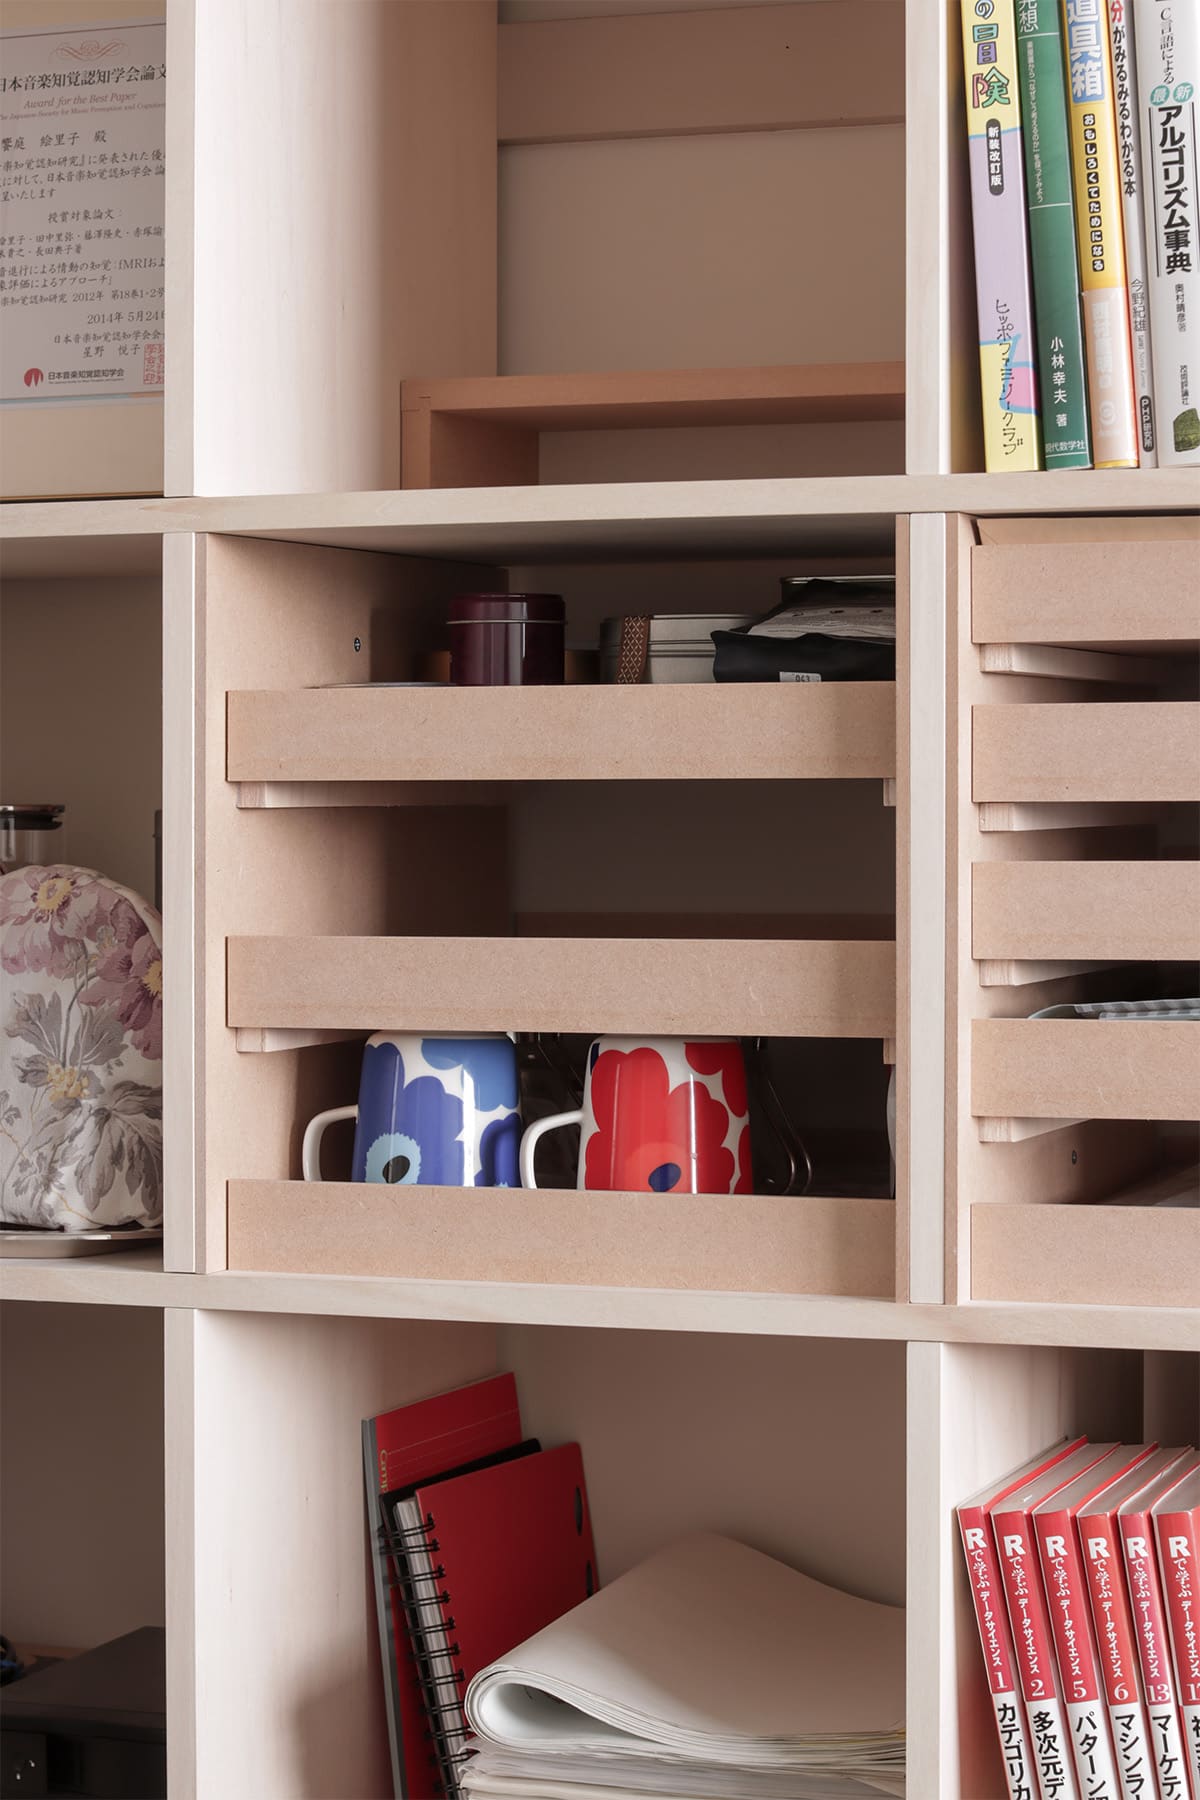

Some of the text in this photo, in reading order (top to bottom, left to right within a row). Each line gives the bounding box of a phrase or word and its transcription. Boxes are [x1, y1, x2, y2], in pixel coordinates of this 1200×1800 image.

[1066, 0, 1103, 98] 道具箱
[23, 92, 137, 109] Award for the Best Paper
[1110, 0, 1137, 197] 分がみるみるわかる本
[988, 126, 1002, 187] 新装改訂版
[1083, 114, 1104, 271] おもしろくてためになる
[1158, 104, 1192, 274] アルゴリズム事典
[87, 311, 124, 325] 2014年
[1050, 336, 1068, 427] 小林幸夫 著
[993, 1671, 1008, 1689] 1
[1030, 1679, 1045, 1697] 2
[1073, 1680, 1087, 1698] 5
[1114, 1682, 1129, 1700] 6
[1147, 1684, 1171, 1702] 13
[1186, 1683, 1200, 1701] 1
[1032, 1710, 1065, 1800] 多次元デ
[1075, 1711, 1109, 1800] パターン
[1114, 1713, 1146, 1800] マシンラ
[1152, 1714, 1182, 1800] マーケテ
